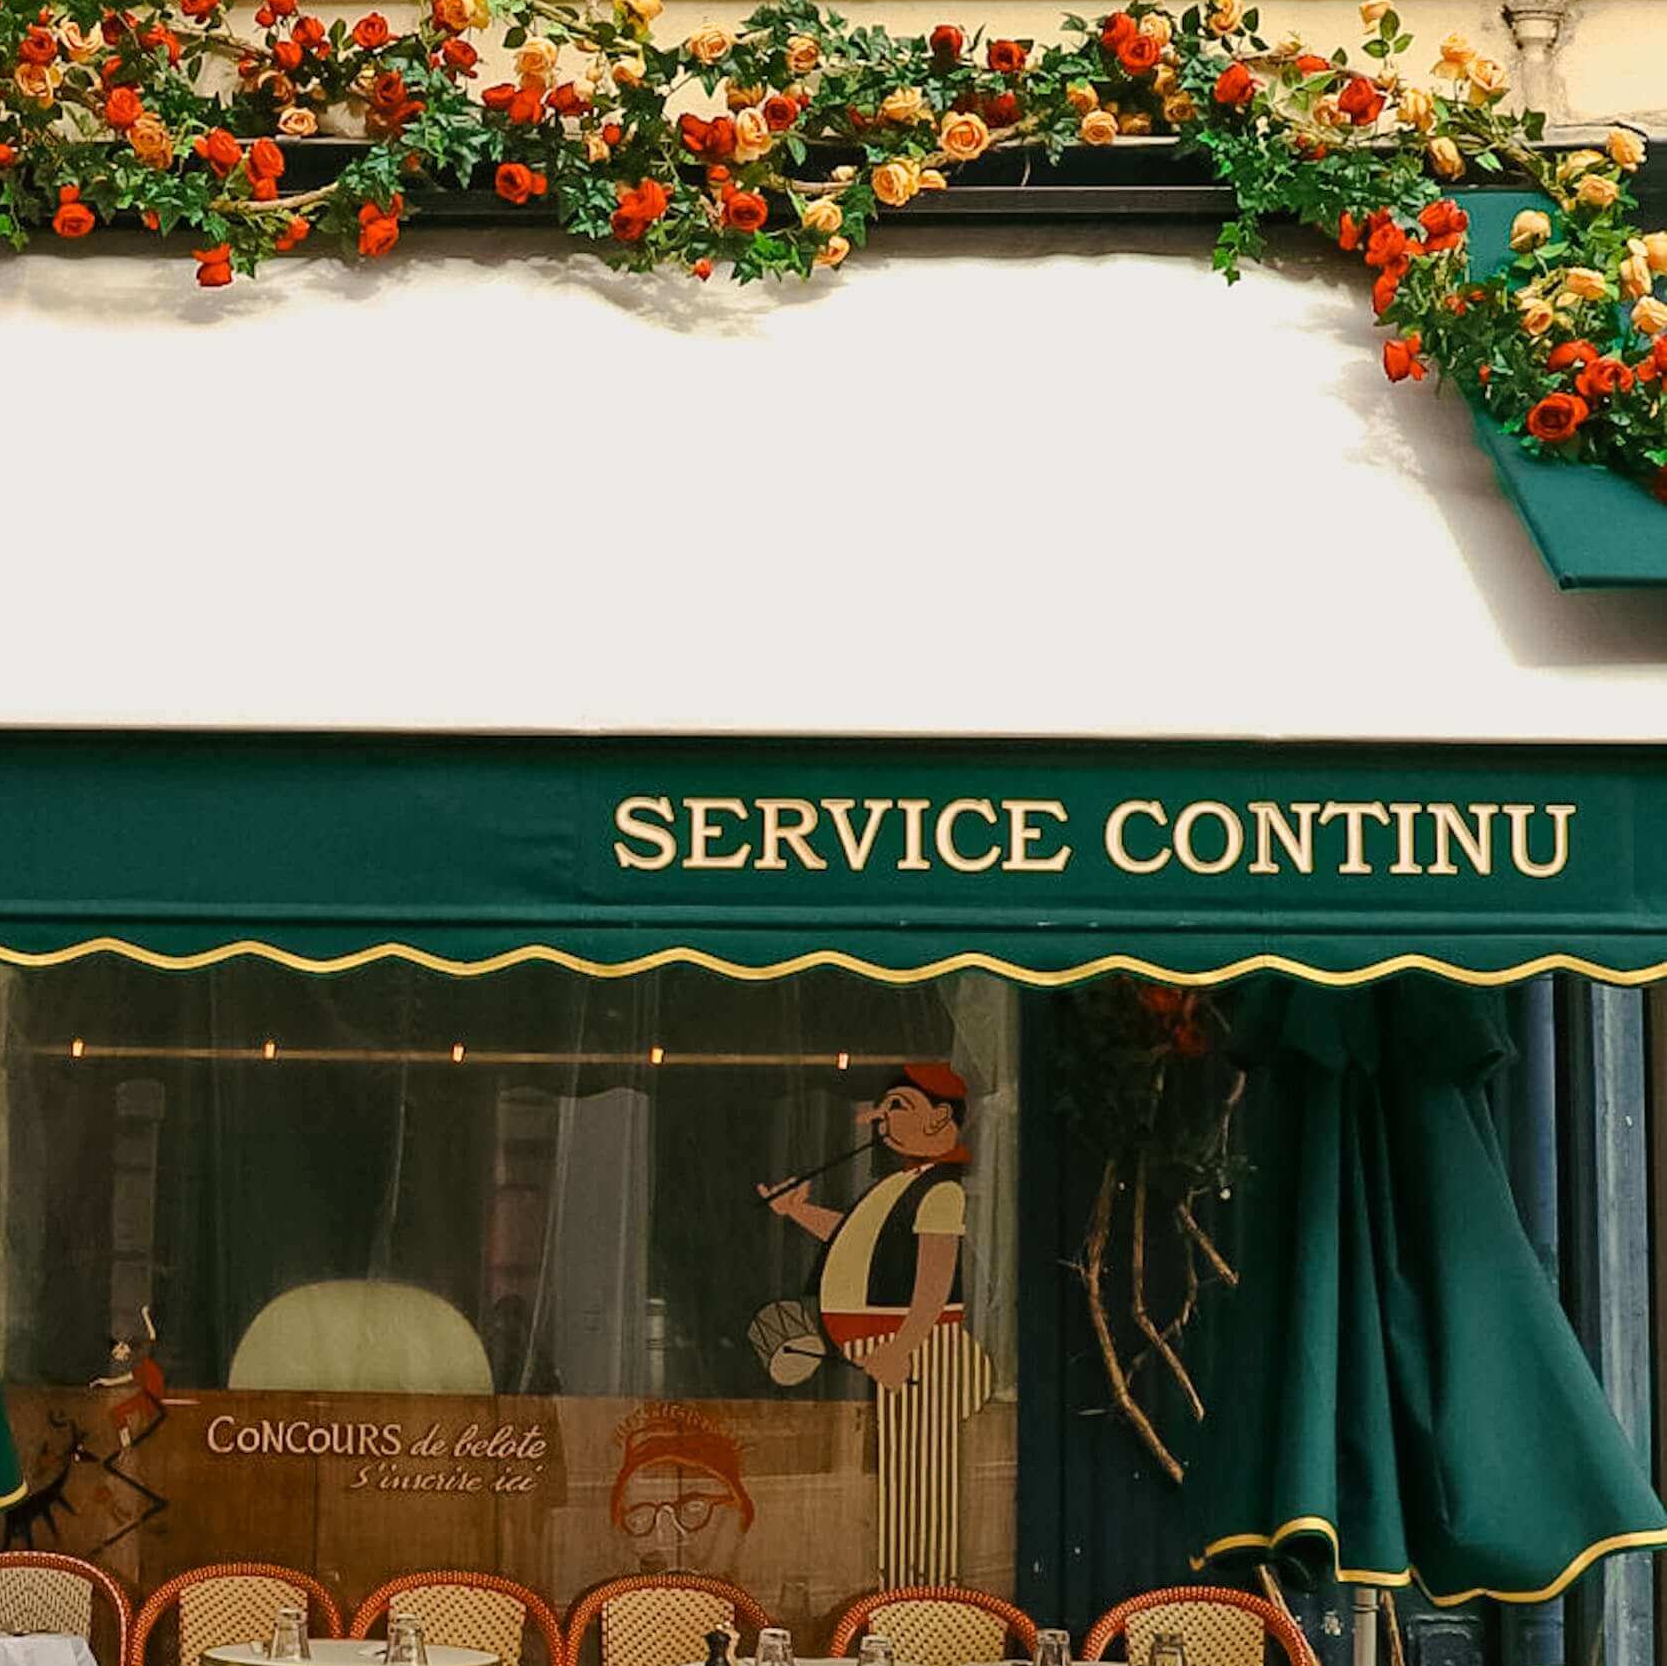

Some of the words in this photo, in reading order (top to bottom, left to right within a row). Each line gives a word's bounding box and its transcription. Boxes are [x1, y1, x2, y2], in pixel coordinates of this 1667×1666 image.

[612, 794, 1073, 874] SERVICE
[1104, 799, 1577, 879] CONTINU
[410, 1424, 447, 1457] de
[453, 1423, 548, 1460] belote
[490, 1464, 544, 1494] ici
